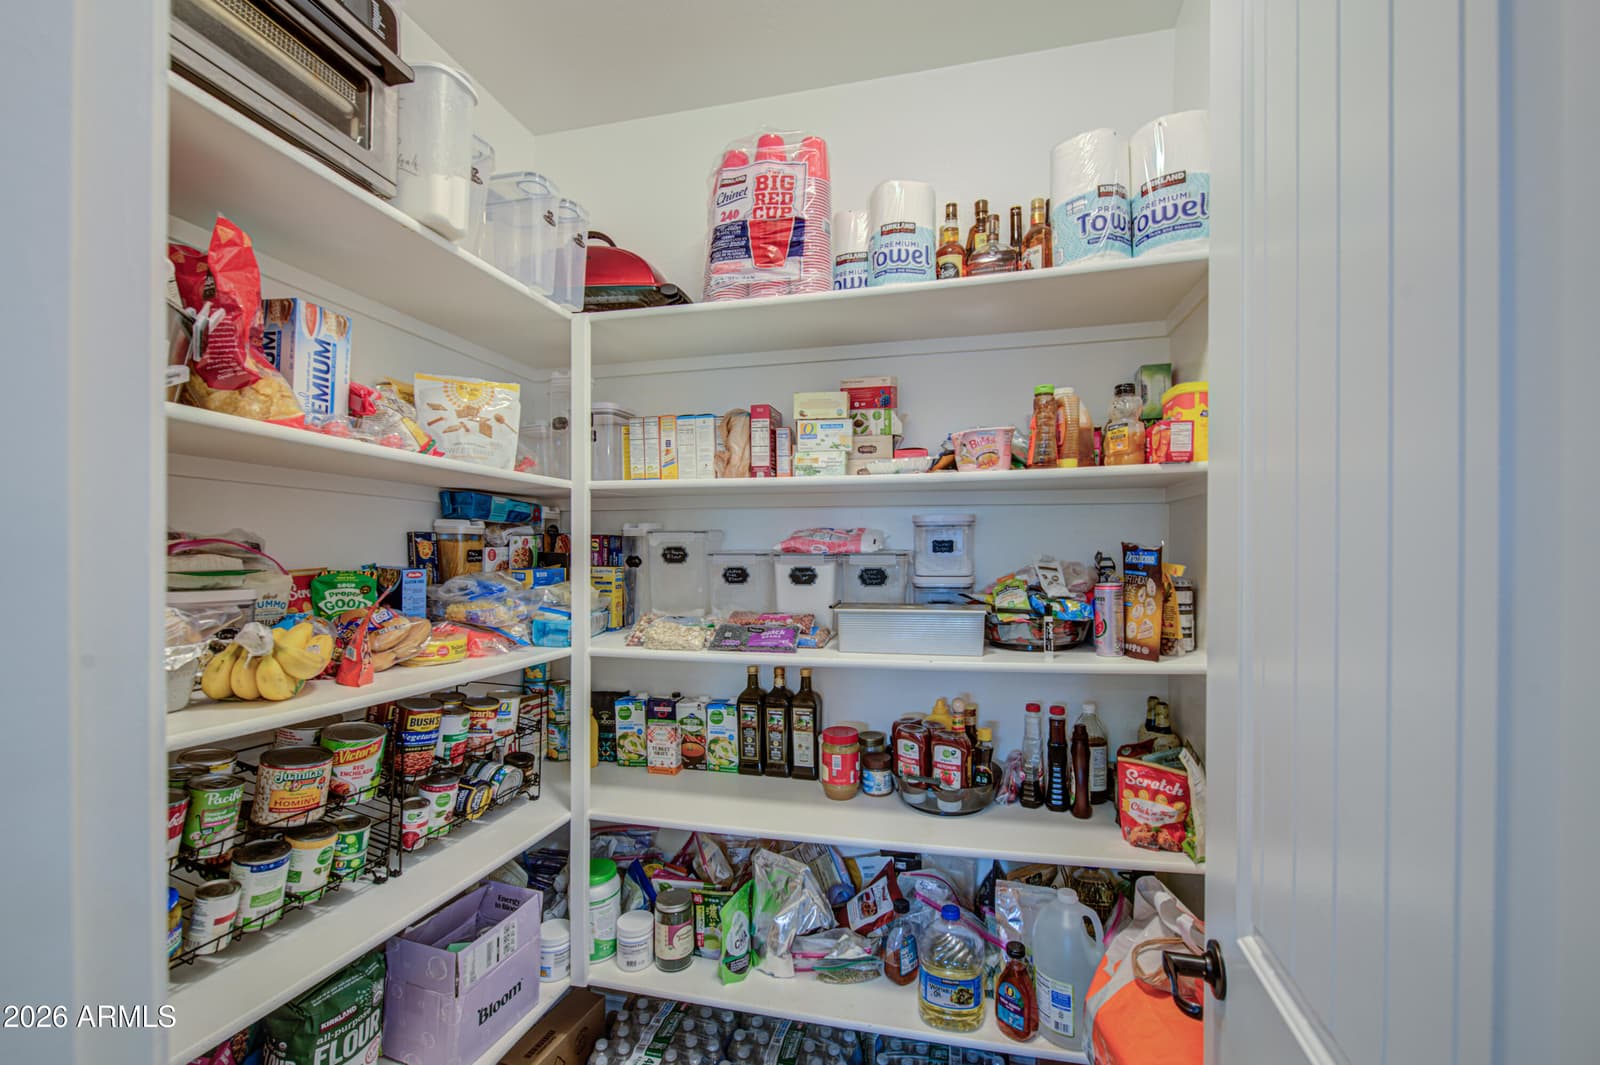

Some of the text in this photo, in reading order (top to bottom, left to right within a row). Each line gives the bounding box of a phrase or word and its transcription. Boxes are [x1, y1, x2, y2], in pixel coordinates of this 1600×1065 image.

[755, 175, 795, 191] BIG
[716, 187, 748, 206] Chinet
[753, 192, 794, 206] RED
[1141, 192, 1188, 212] PREMIUM
[720, 208, 740, 223] 240
[752, 206, 793, 220] CUP
[1077, 212, 1130, 235] Tow
[880, 240, 917, 248] PREMIUM
[1124, 768, 1185, 797] Scratch
[273, 795, 318, 808] HOMINY
[477, 979, 523, 1026] Bloom
[316, 1007, 371, 1046] all-purpose
[320, 1004, 358, 1030] KIRKLAND
[314, 1009, 381, 1065] FLOUR
